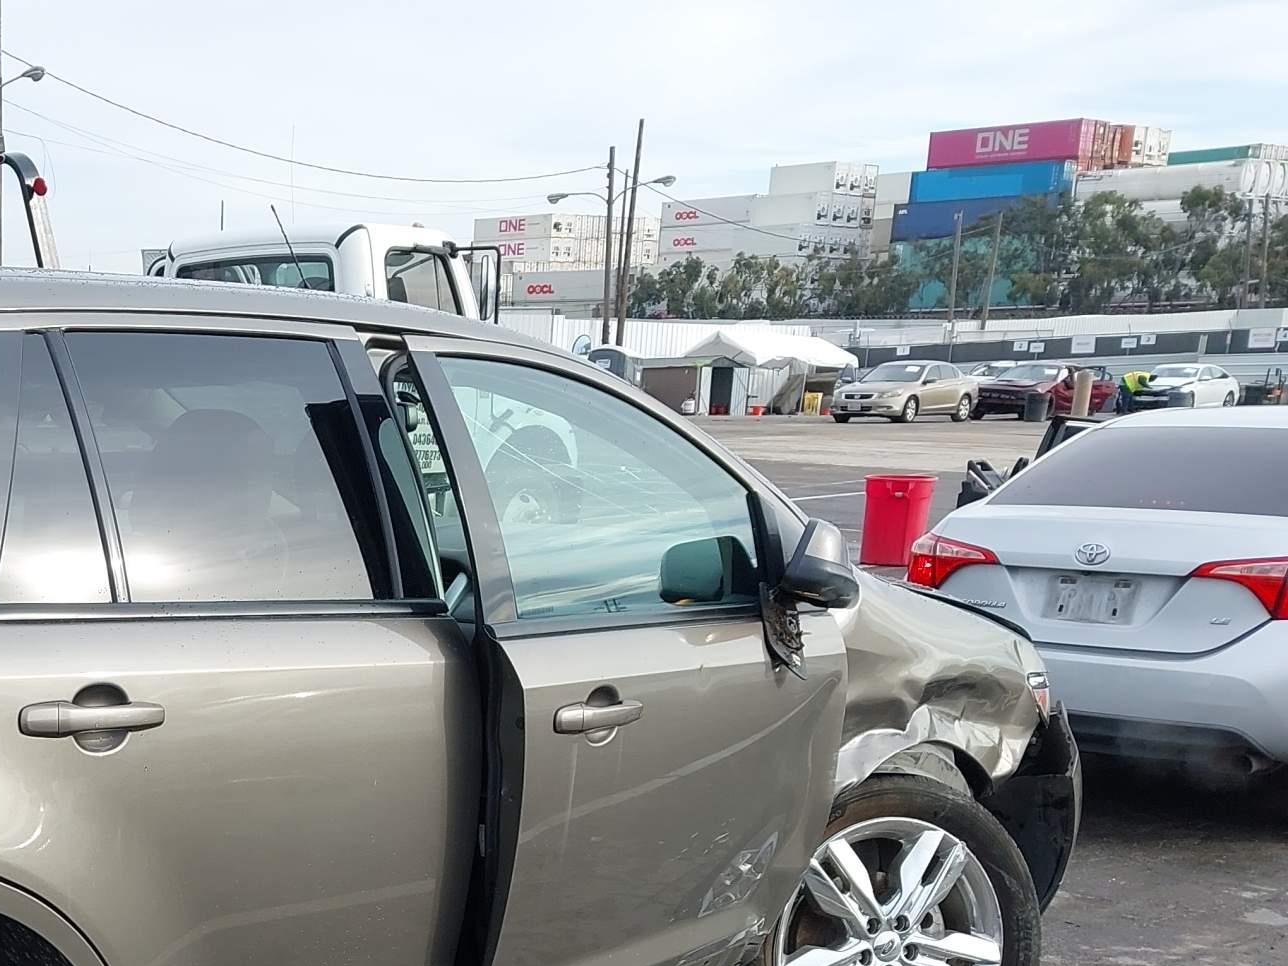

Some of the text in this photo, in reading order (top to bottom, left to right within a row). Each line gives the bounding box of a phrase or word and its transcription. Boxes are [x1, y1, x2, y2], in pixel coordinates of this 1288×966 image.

[975, 128, 1030, 153] ONE
[674, 210, 700, 221] OOCL
[499, 218, 526, 233] ONE
[672, 236, 697, 247] OOCL
[498, 242, 525, 257] ONE
[526, 284, 555, 295] OOCL
